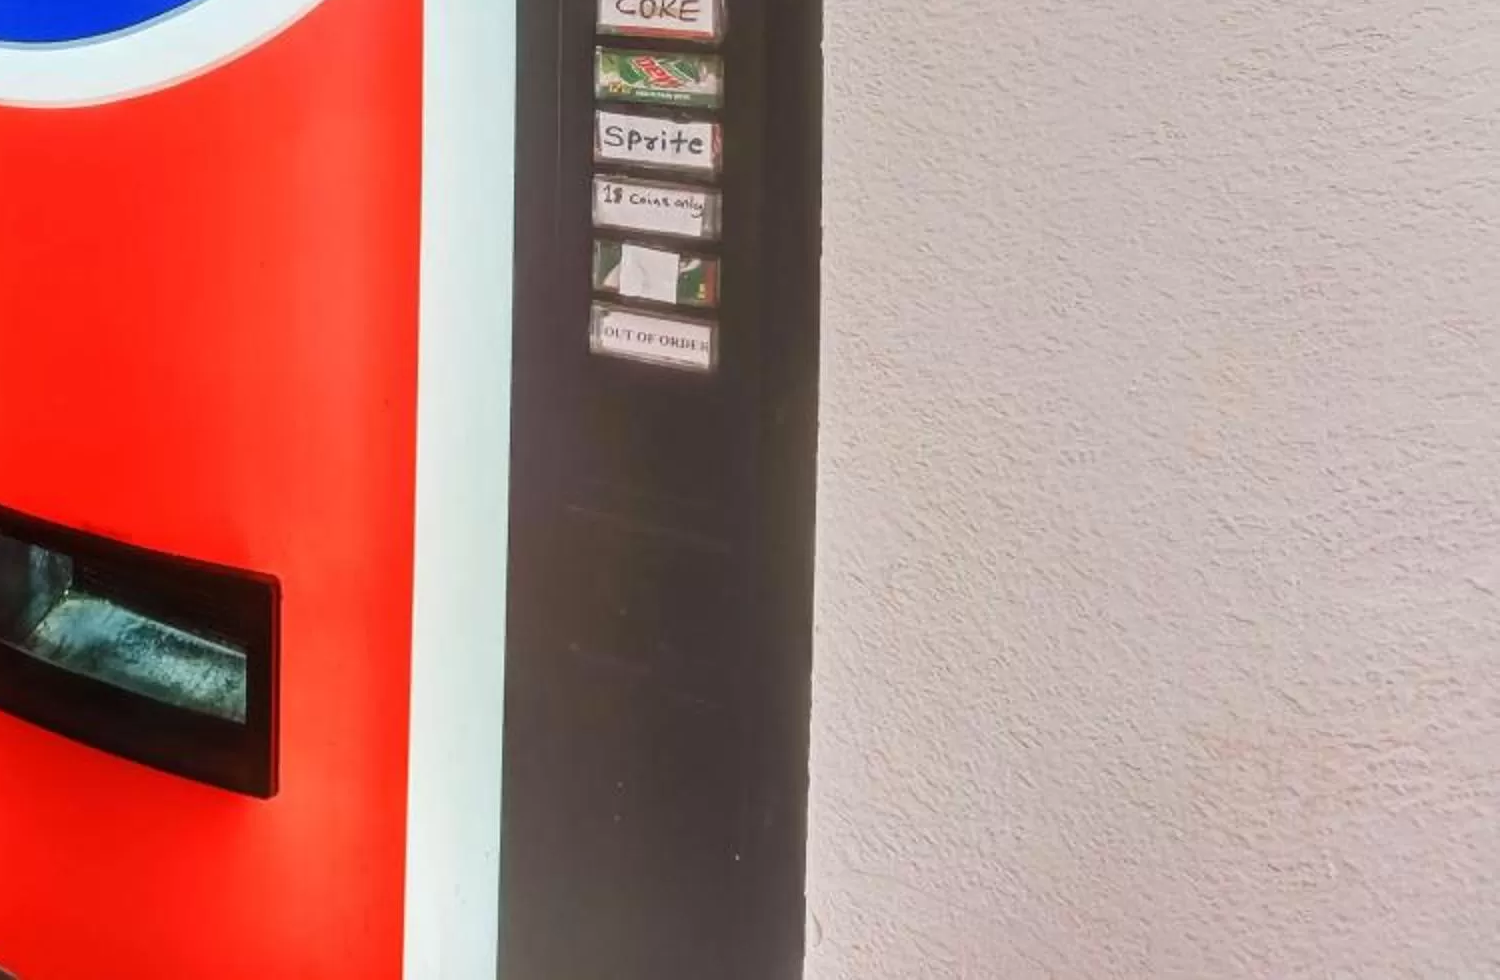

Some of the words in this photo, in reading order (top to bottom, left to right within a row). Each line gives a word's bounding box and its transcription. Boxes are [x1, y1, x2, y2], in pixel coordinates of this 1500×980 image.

[603, 125, 704, 155] Sprite
[604, 325, 634, 341] OUT
[637, 332, 657, 344] OF
[659, 335, 709, 353] ORDER
